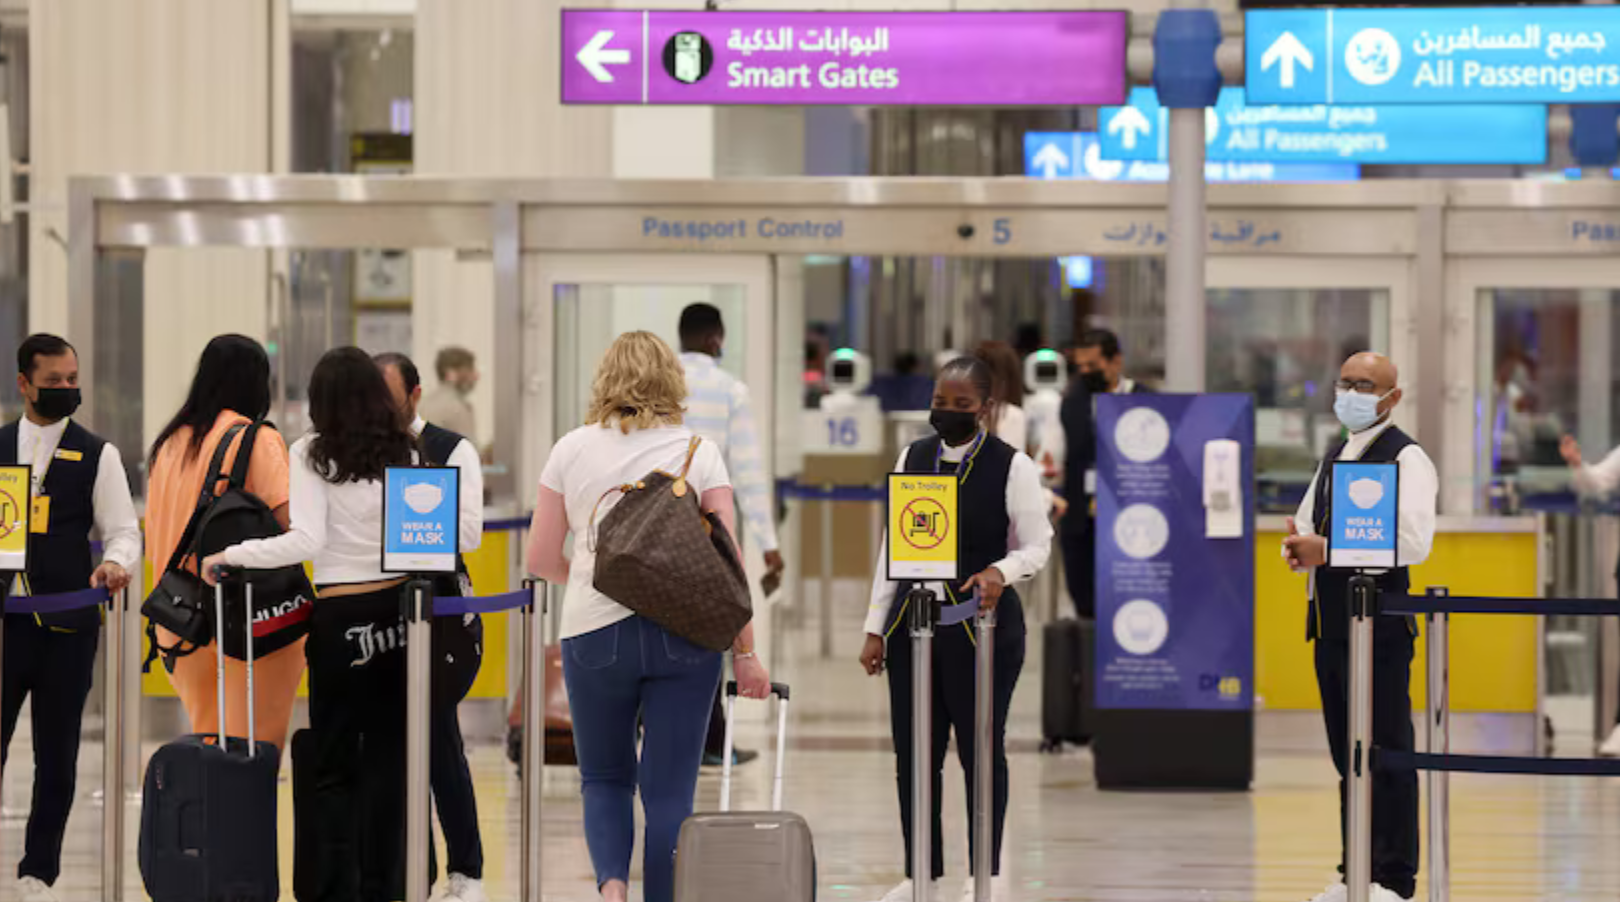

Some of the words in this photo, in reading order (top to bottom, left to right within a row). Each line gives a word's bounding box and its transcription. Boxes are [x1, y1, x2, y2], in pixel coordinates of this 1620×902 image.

[727, 26, 793, 56] الذكية
[798, 26, 889, 56] البوابات
[1413, 24, 1541, 56] المسافرين
[1546, 31, 1606, 60] جميع
[727, 61, 811, 88] Smart
[818, 61, 899, 88] Gates
[1413, 60, 1454, 88] All
[1463, 60, 1620, 93] Passengers
[1226, 129, 1260, 150] All
[1264, 128, 1388, 156] Passengers
[642, 218, 746, 240] Passport
[757, 218, 843, 238] Control
[992, 219, 1012, 244] 5
[827, 418, 859, 446] 16
[901, 481, 915, 490] No
[917, 480, 948, 493] Trolley
[401, 521, 433, 530] WEAR
[434, 521, 444, 530] A
[1344, 528, 1386, 541] MASK
[1345, 516, 1374, 526] WEAR
[401, 532, 445, 545] MASK
